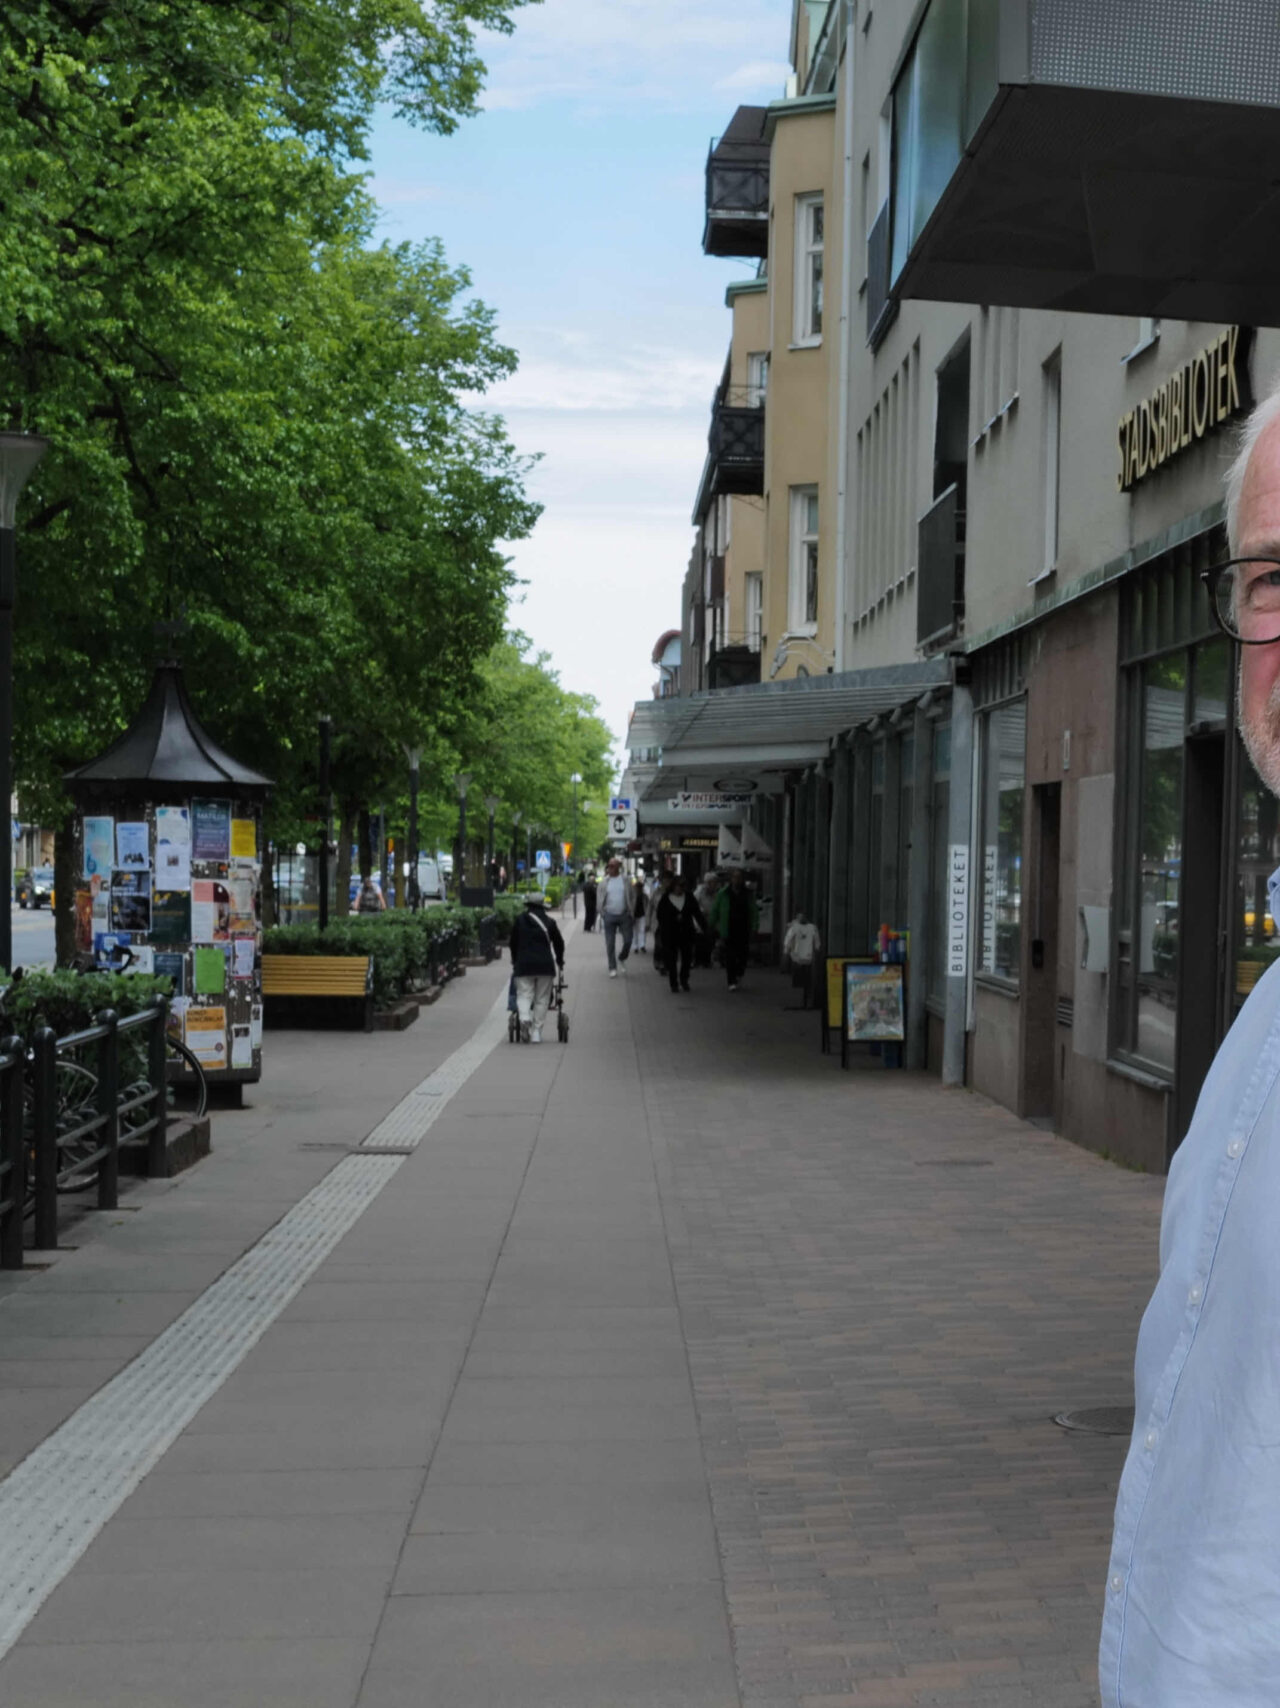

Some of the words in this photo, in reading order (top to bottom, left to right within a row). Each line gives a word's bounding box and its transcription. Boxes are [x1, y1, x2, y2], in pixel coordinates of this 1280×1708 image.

[1116, 325, 1240, 492] STADSBIBLIOTEK
[692, 794, 753, 802] INTERSPORT
[952, 849, 965, 972] BIBLIOTEKET
